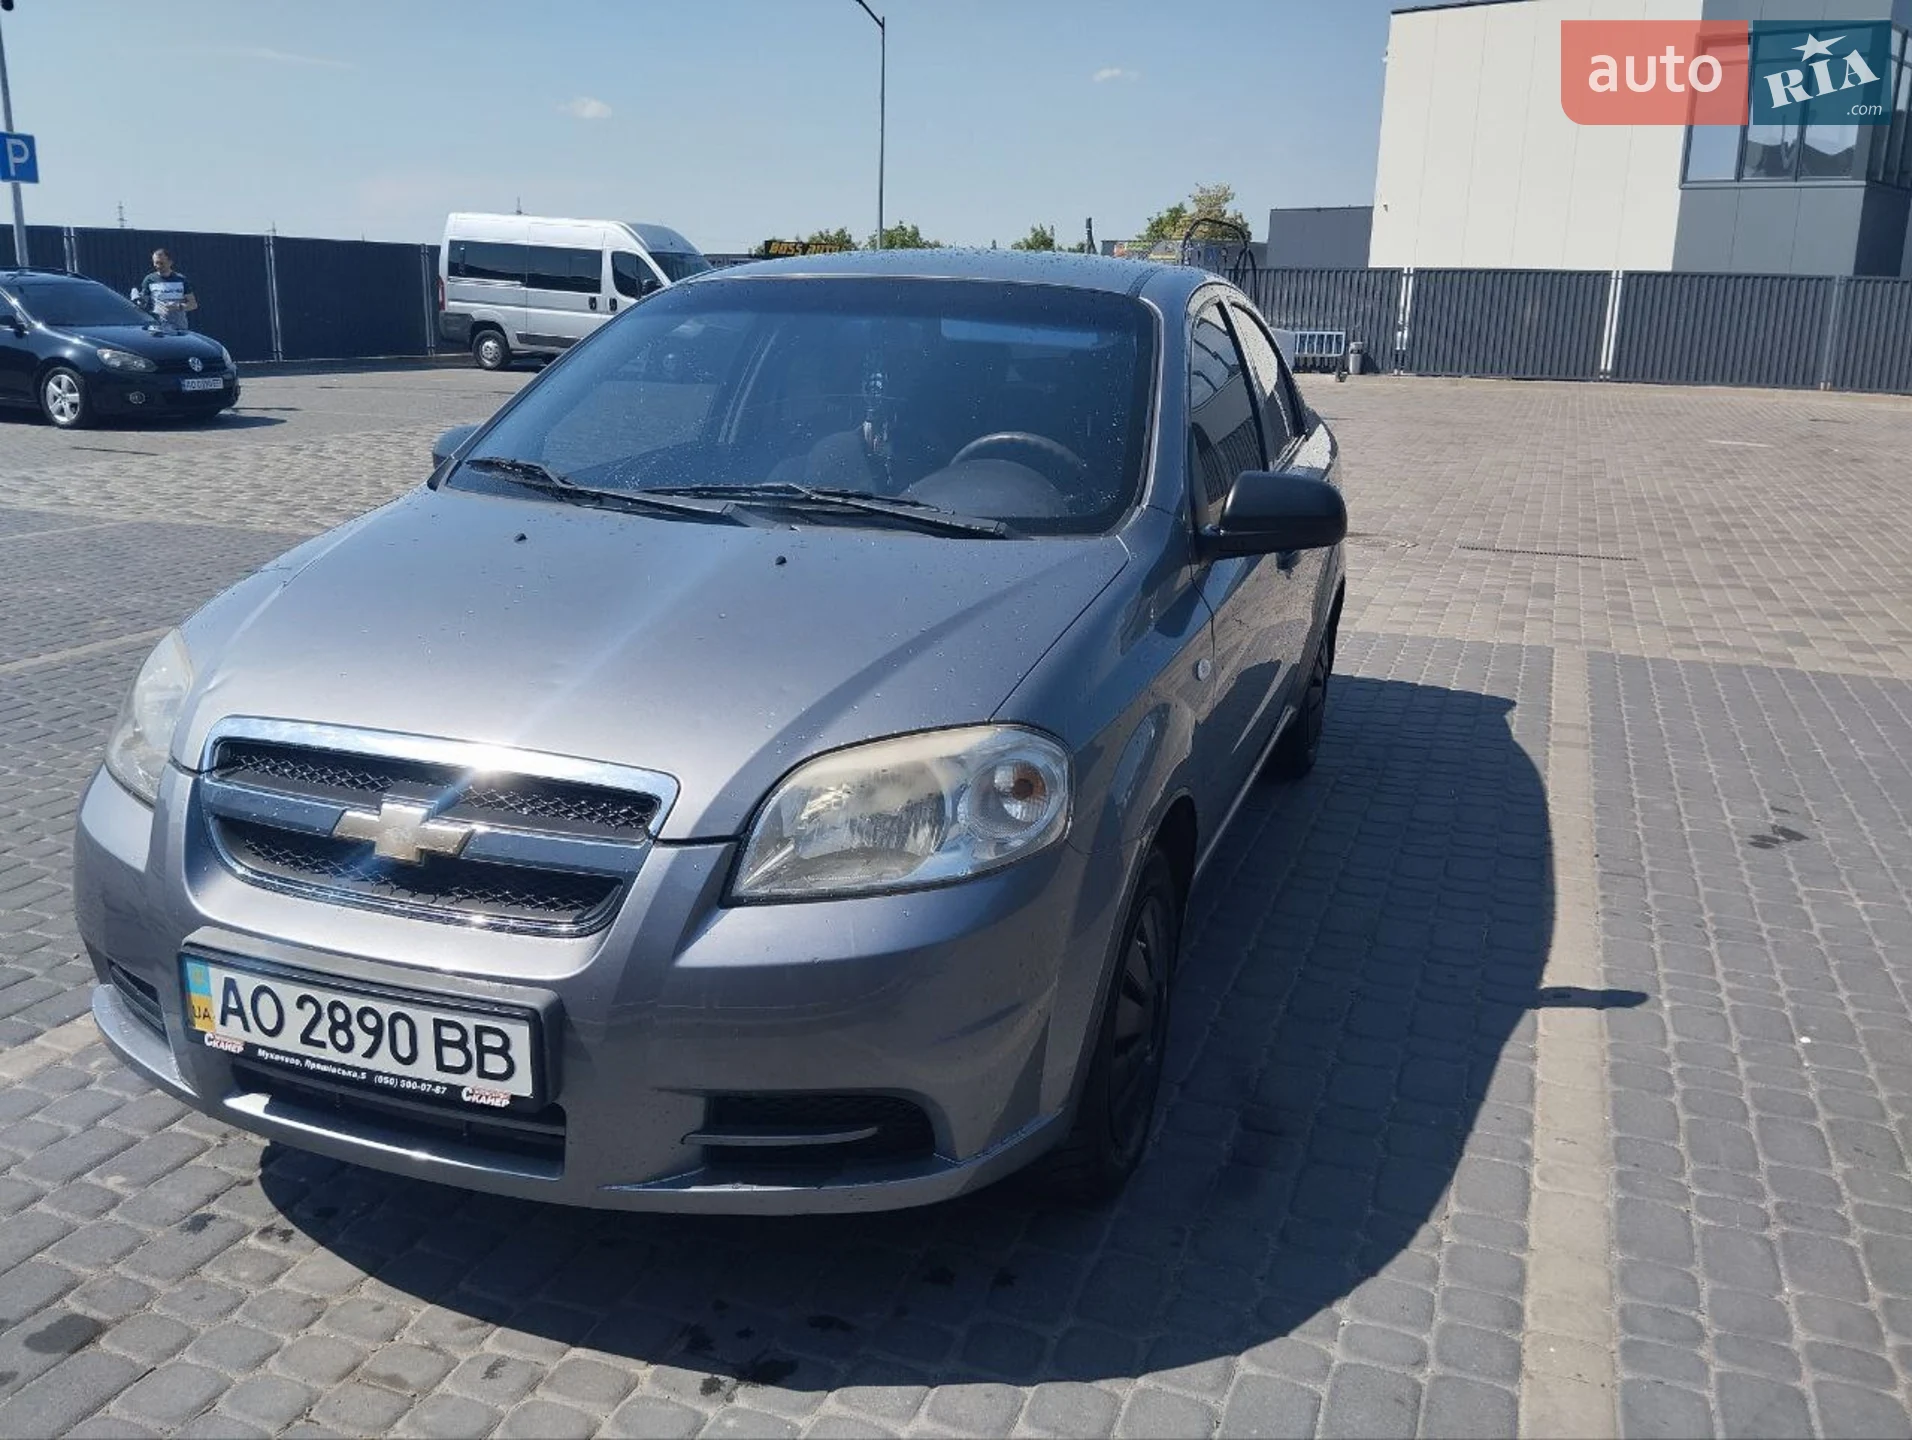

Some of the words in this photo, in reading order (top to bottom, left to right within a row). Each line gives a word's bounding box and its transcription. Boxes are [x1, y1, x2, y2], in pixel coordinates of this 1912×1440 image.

[5, 138, 30, 177] P
[769, 242, 803, 255] BOSS
[193, 1004, 212, 1021] UA
[220, 976, 285, 1038] AO
[296, 993, 418, 1066] 2890
[433, 1017, 515, 1082] BB
